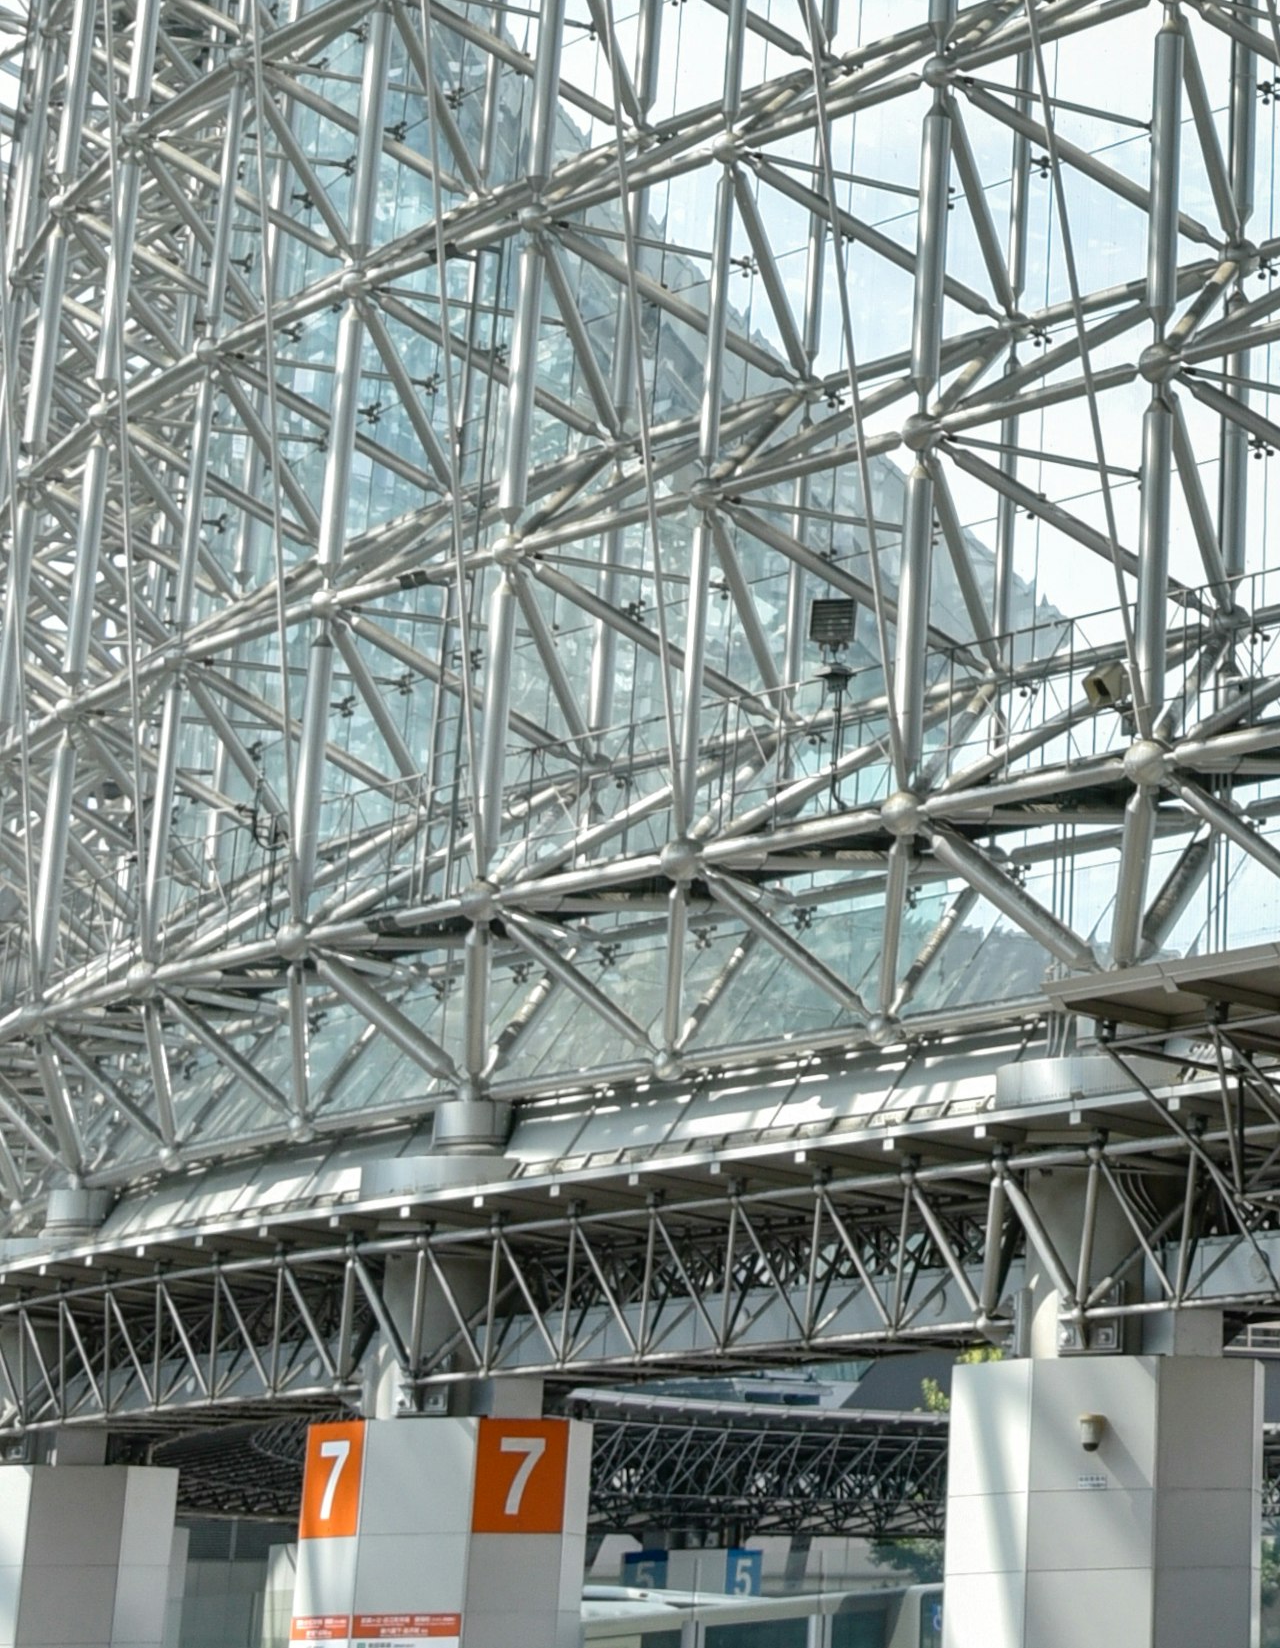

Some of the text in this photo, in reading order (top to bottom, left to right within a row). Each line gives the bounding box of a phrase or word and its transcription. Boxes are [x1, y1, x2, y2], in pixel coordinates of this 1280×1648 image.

[320, 1439, 351, 1520] 7
[500, 1437, 546, 1515] 7
[734, 1558, 753, 1595] 5
